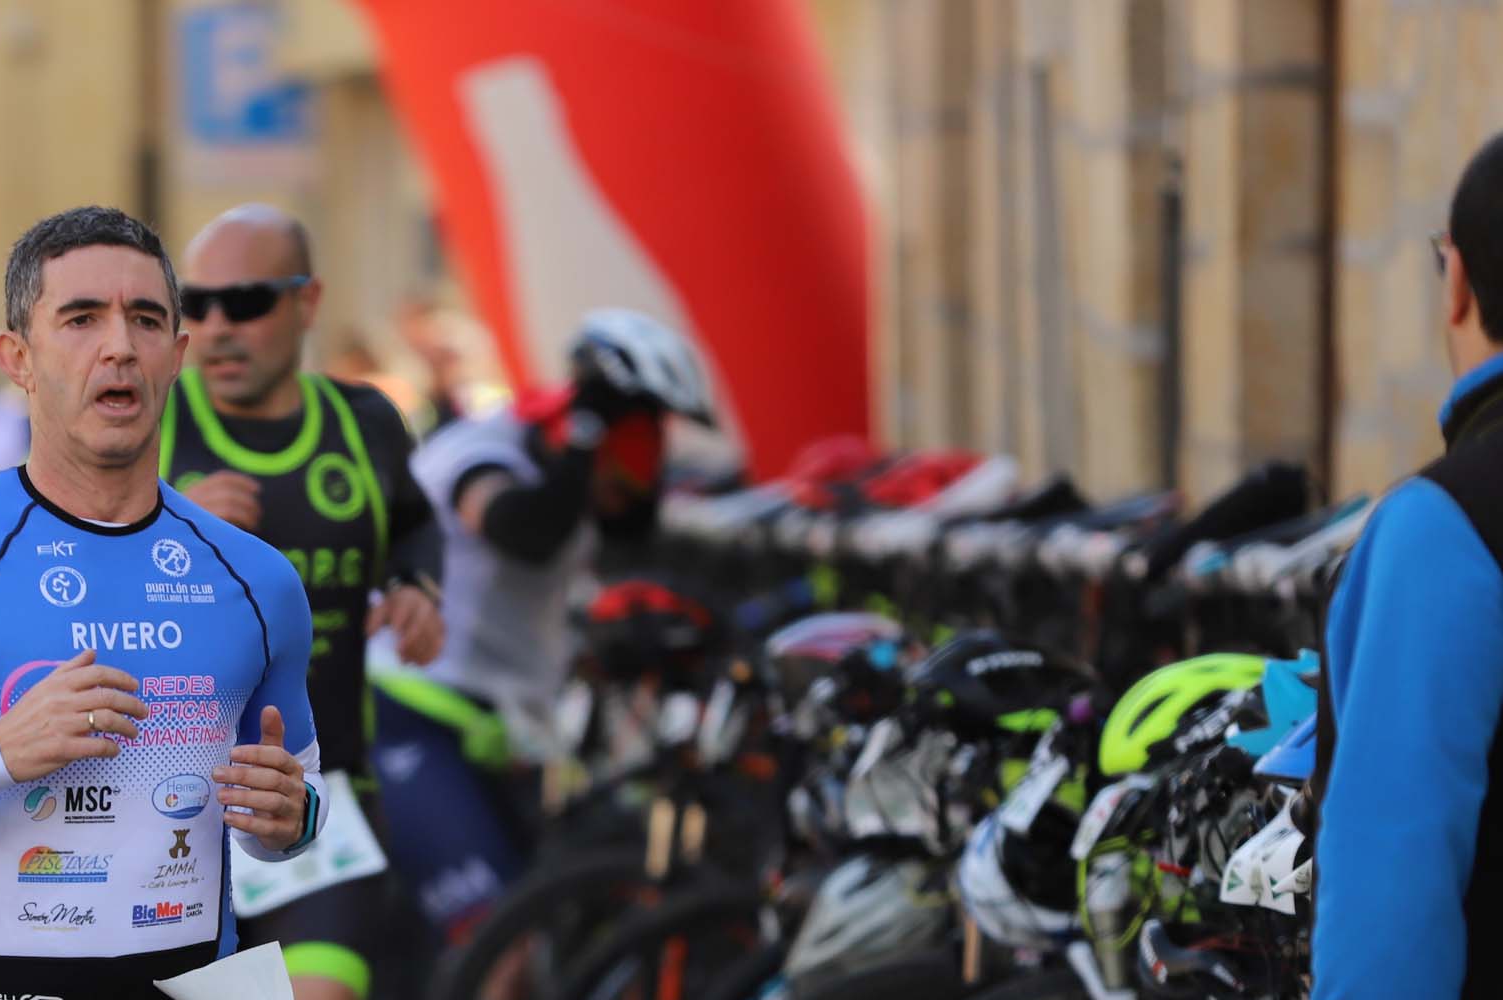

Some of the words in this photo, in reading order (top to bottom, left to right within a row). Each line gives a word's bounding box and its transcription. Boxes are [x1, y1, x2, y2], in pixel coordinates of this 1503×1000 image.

[190, 584, 214, 594] CLUB
[71, 621, 183, 650] RIVERO
[142, 675, 216, 697] REDES
[147, 701, 219, 721] PTICAS
[64, 785, 113, 812] MSC
[25, 854, 114, 871] PISCINAS
[132, 900, 184, 922] BigMat
